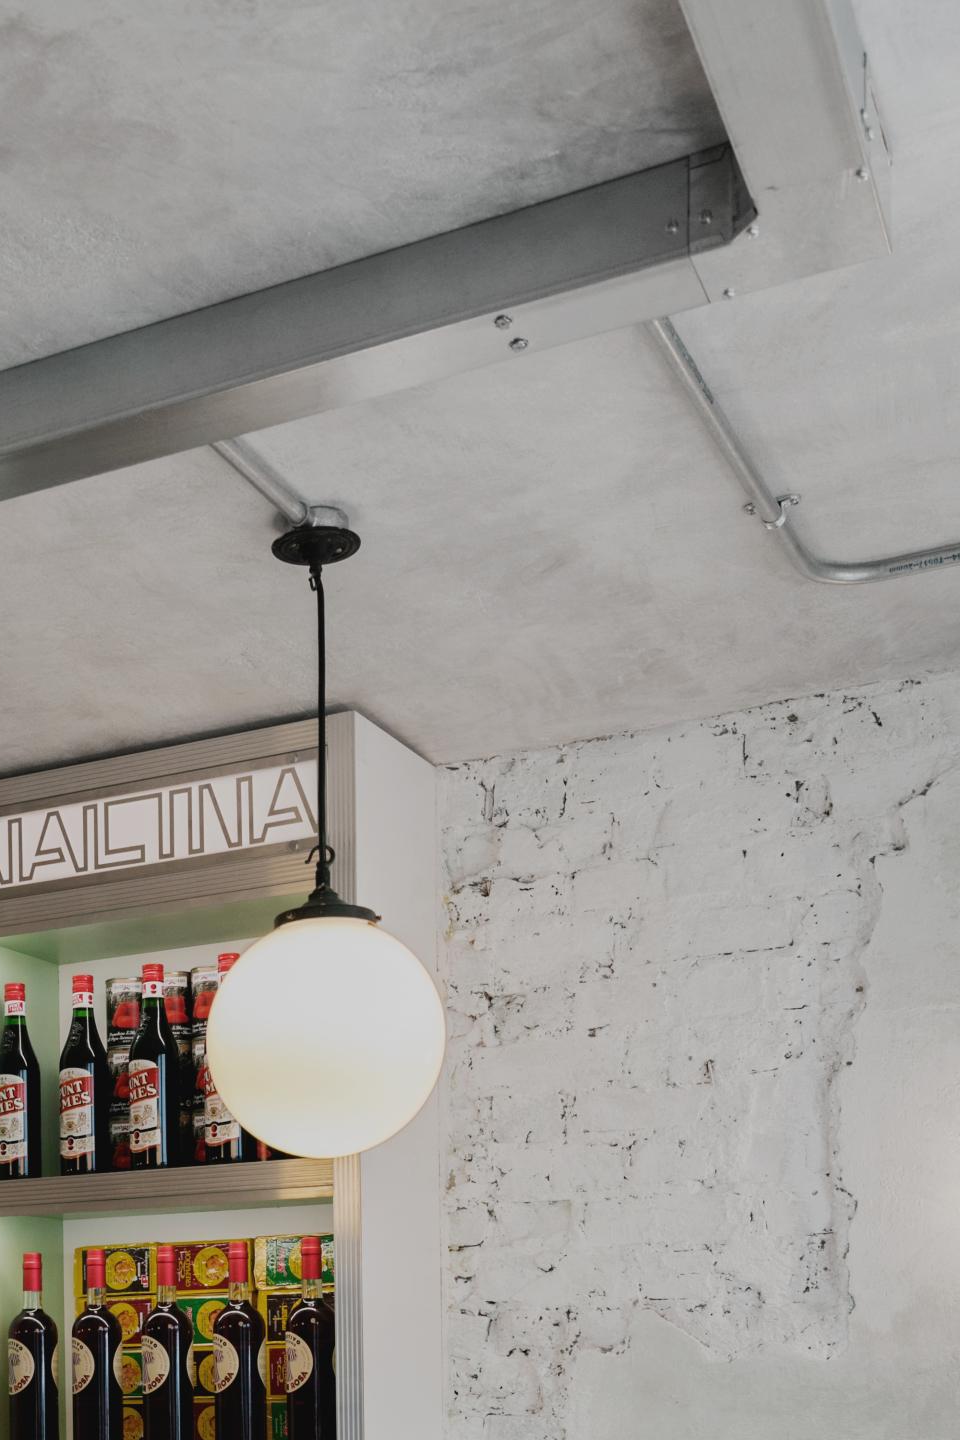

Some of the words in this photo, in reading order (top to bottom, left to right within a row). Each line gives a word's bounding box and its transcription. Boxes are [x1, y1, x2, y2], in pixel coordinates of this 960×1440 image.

[13, 1375, 30, 1392] ROSA
[74, 1374, 90, 1391] ROSA
[147, 1373, 165, 1391] ROSA
[217, 1372, 235, 1390] ROSA
[290, 1371, 308, 1389] ROSA
